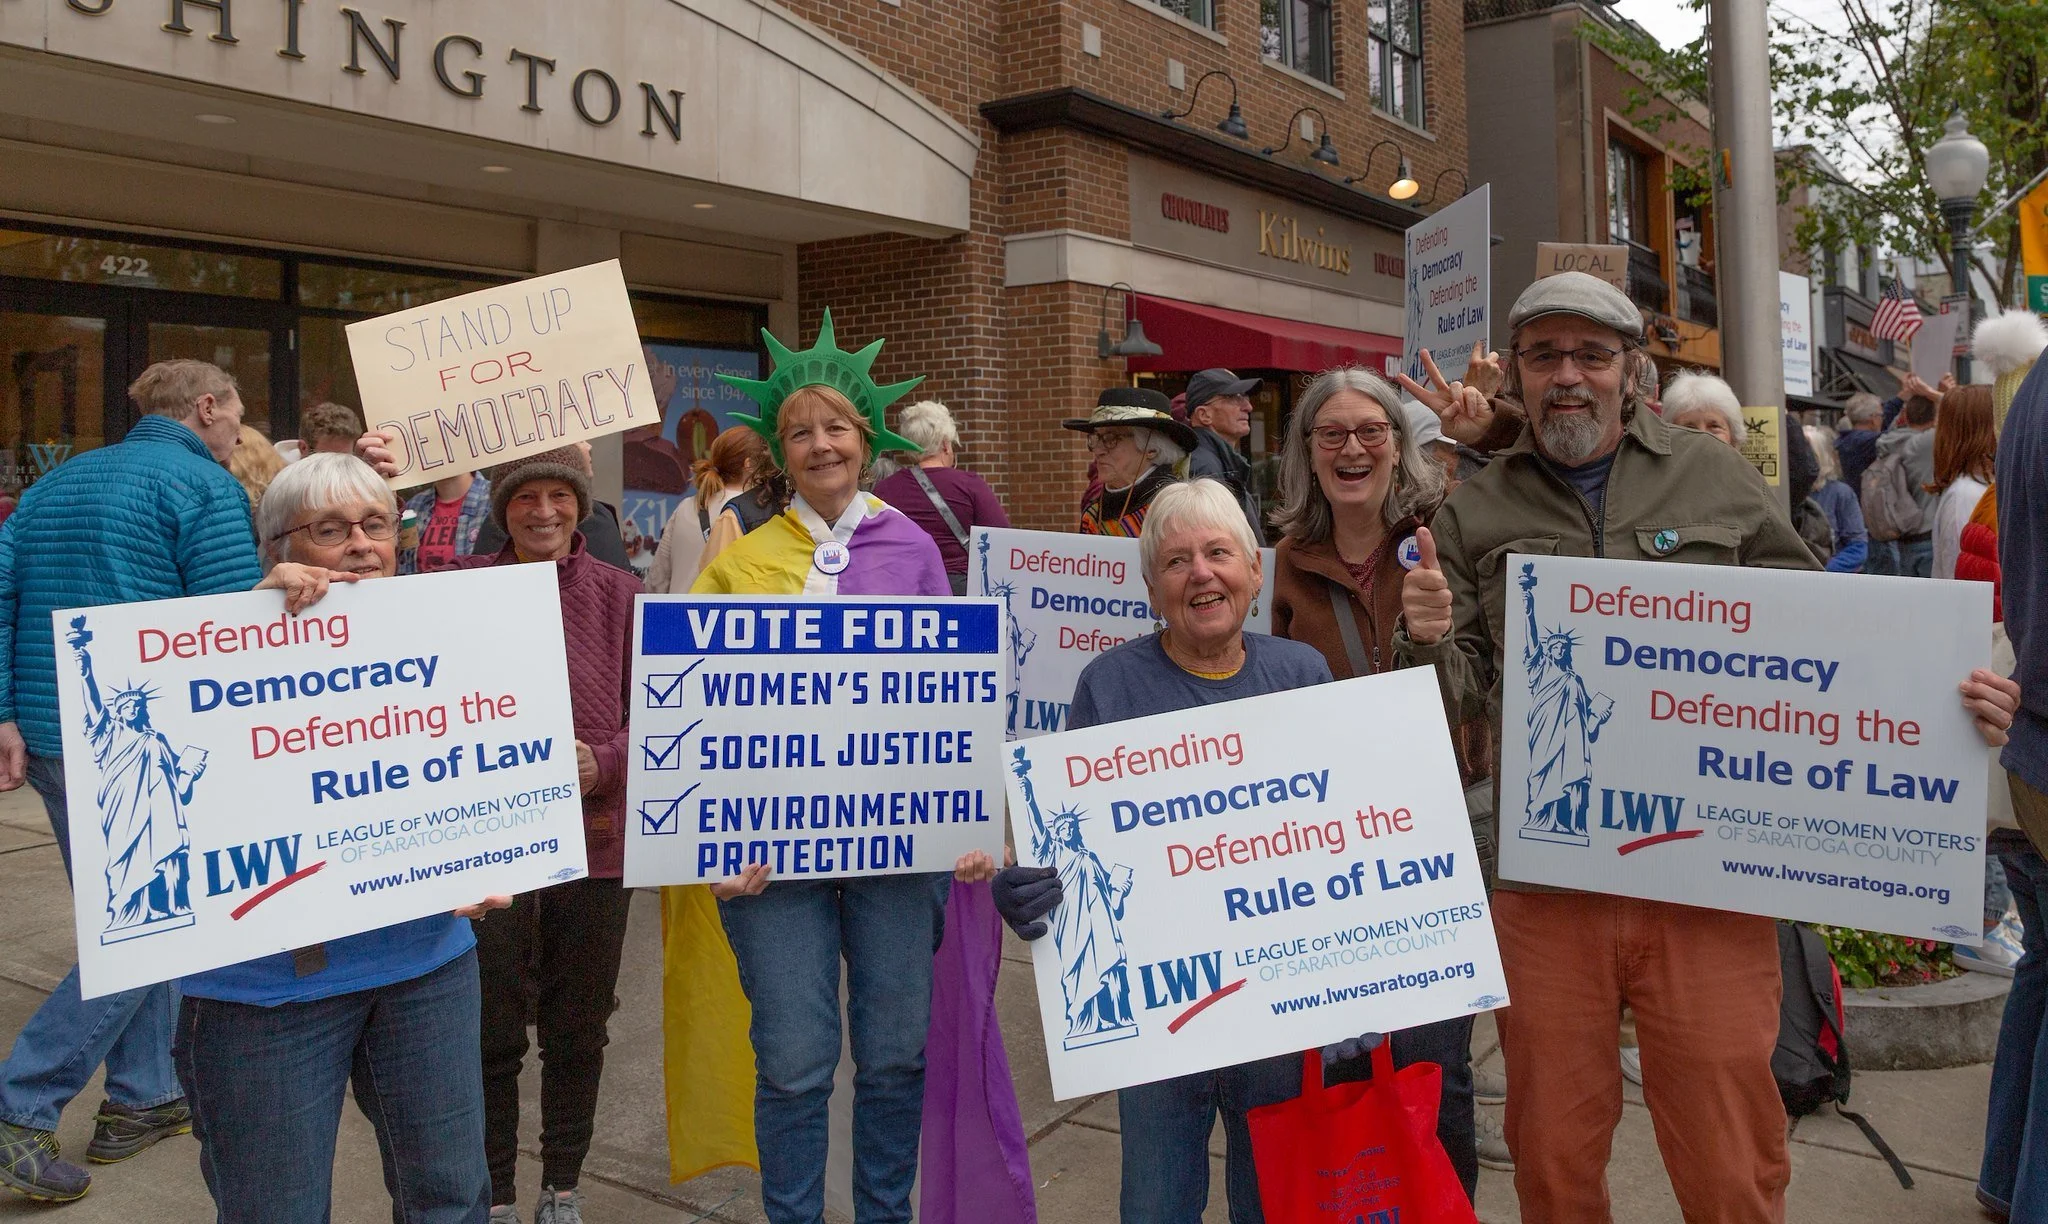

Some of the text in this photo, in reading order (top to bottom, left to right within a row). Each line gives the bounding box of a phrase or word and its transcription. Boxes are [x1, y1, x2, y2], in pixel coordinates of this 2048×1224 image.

[1161, 191, 1230, 234] CHOCOLATES
[1257, 208, 1350, 276] Kilwins
[1415, 226, 1447, 256] Defending
[1421, 250, 1463, 281] Democracy
[1553, 253, 1615, 273] LOCAL
[100, 254, 149, 278] 422
[1429, 273, 1478, 308] Defending the
[385, 287, 572, 372] STAND UP
[1437, 305, 1484, 336] Rule of Law
[439, 350, 543, 392] FOR
[679, 362, 714, 385] every
[681, 384, 715, 400] since
[376, 363, 635, 478] DEMOCRACY
[3, 465, 35, 475] THE
[1010, 548, 1126, 585] Defending
[687, 608, 960, 650] VOTE FOR:
[1570, 584, 1751, 633] Defending
[138, 612, 349, 663] Defending
[189, 655, 438, 713] Democracy
[702, 669, 998, 707] WOMEN'S RIGHTS
[1605, 636, 1839, 692] Democracy
[251, 692, 516, 760] Defending the
[1651, 690, 1920, 746] Defending the
[312, 738, 552, 804] Rule of Law
[700, 730, 973, 771] SOCIAL JUSTICE
[1065, 733, 1243, 787] Defending
[1699, 746, 1958, 803] Rule of Law
[316, 820, 396, 850] LEAGUE
[400, 817, 422, 832] OF
[424, 798, 500, 826] WOMEN
[699, 789, 990, 833] ENVIRONMENTAL
[1111, 769, 1329, 833] Democracy
[1600, 789, 1685, 833] LWV
[1697, 804, 1775, 828] LEAGUE
[1777, 816, 1803, 831] OF
[1804, 817, 1886, 842] WOMEN
[341, 806, 547, 863] OF SARATOGA COUNTY
[698, 834, 914, 878] PROTECTION
[1167, 805, 1413, 877] Defending the
[1717, 826, 1942, 866] OF SARATOGA COUNTY
[203, 833, 302, 897] LWV
[350, 838, 558, 895] www.lwvsaratoga.org
[1224, 853, 1454, 921] Rule of Law
[1722, 861, 1950, 904] www.lwvsaratoga.org
[1235, 938, 1308, 967] LEAGUE
[1312, 936, 1331, 951] OF
[1334, 918, 1409, 946] WOMEN
[1260, 927, 1457, 981] OF SARATOGA COUNTY
[1138, 950, 1222, 1010] LWV
[1271, 962, 1475, 1015] www.lwvsaratoga.org
